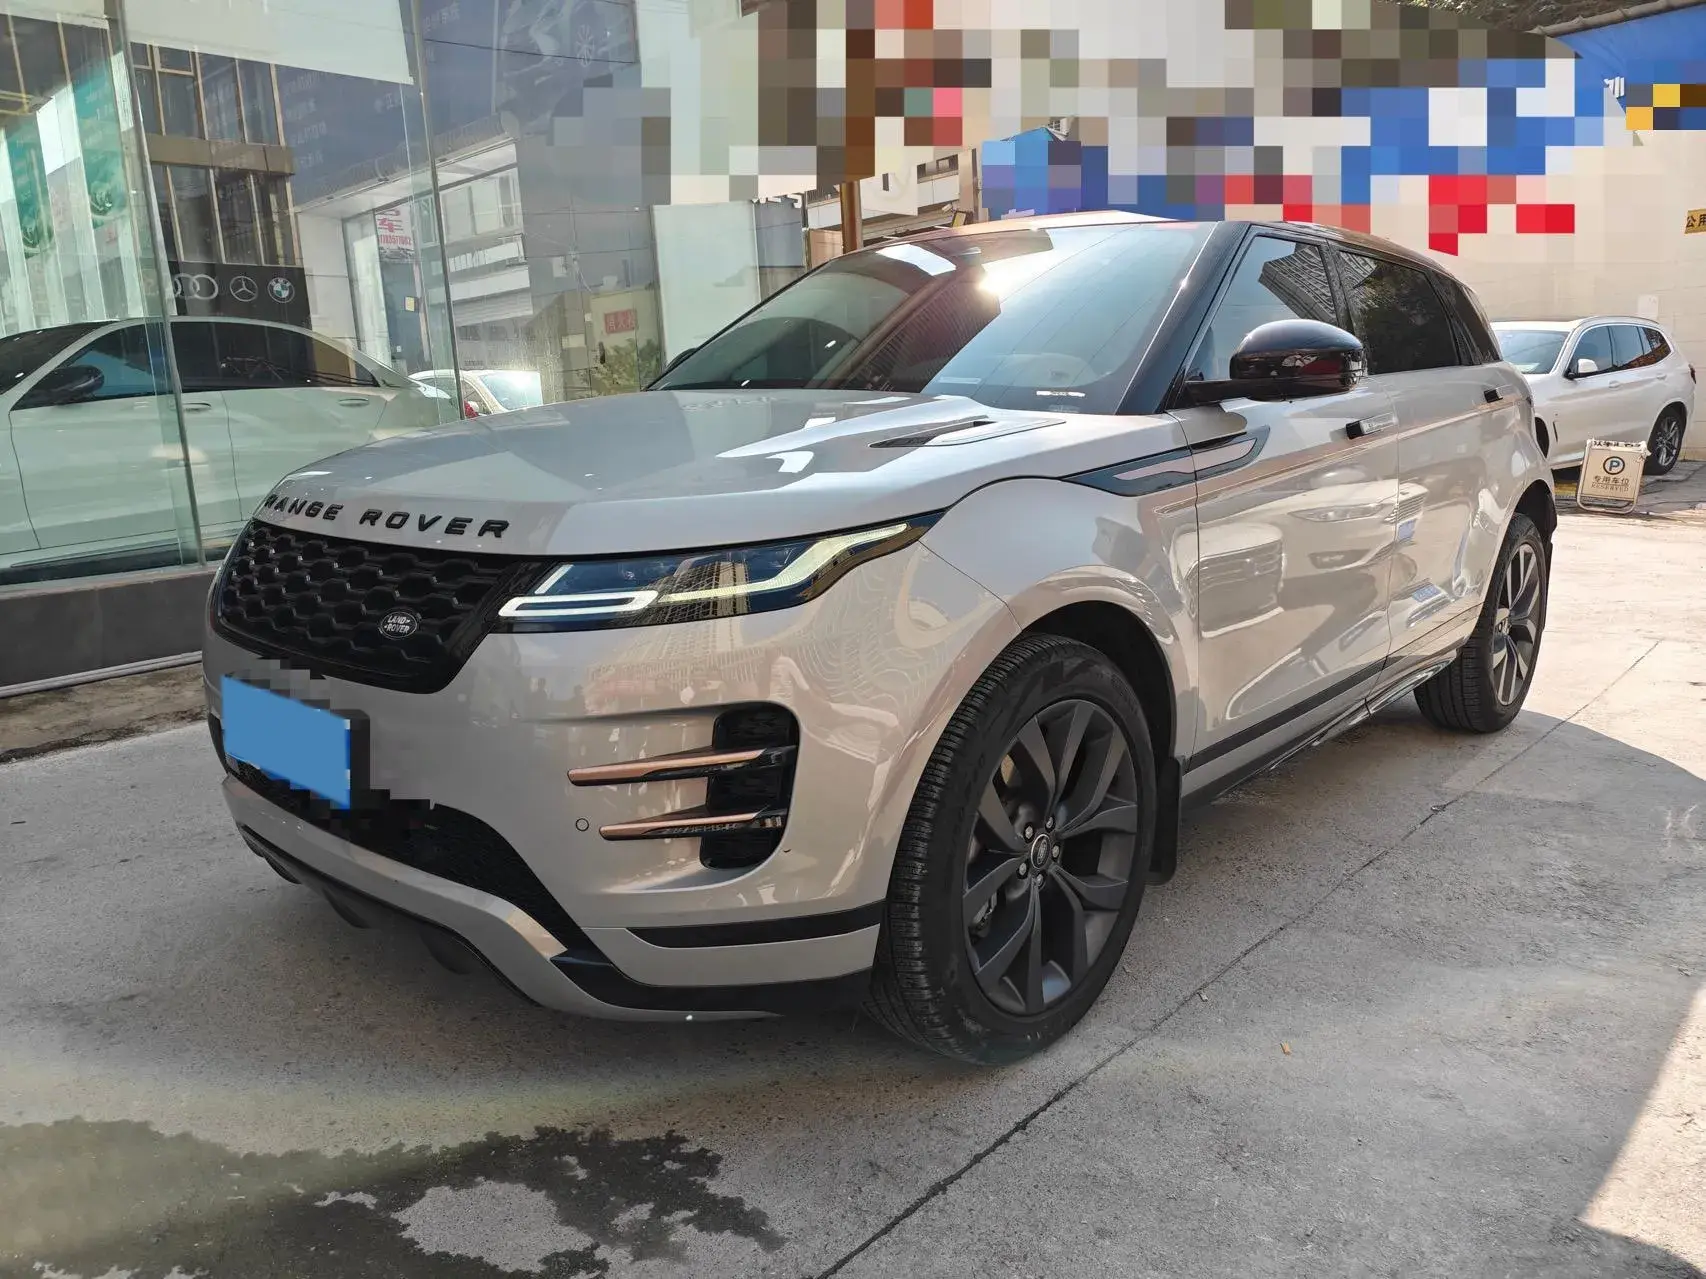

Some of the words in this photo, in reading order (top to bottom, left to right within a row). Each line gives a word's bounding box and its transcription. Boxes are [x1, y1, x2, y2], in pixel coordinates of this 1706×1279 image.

[1608, 460, 1621, 471] P
[1594, 475, 1630, 485] 专用车位
[263, 493, 344, 521] RANGE
[359, 508, 510, 538] ROVER
[387, 615, 407, 625] LAND
[386, 623, 411, 634] ROVER
